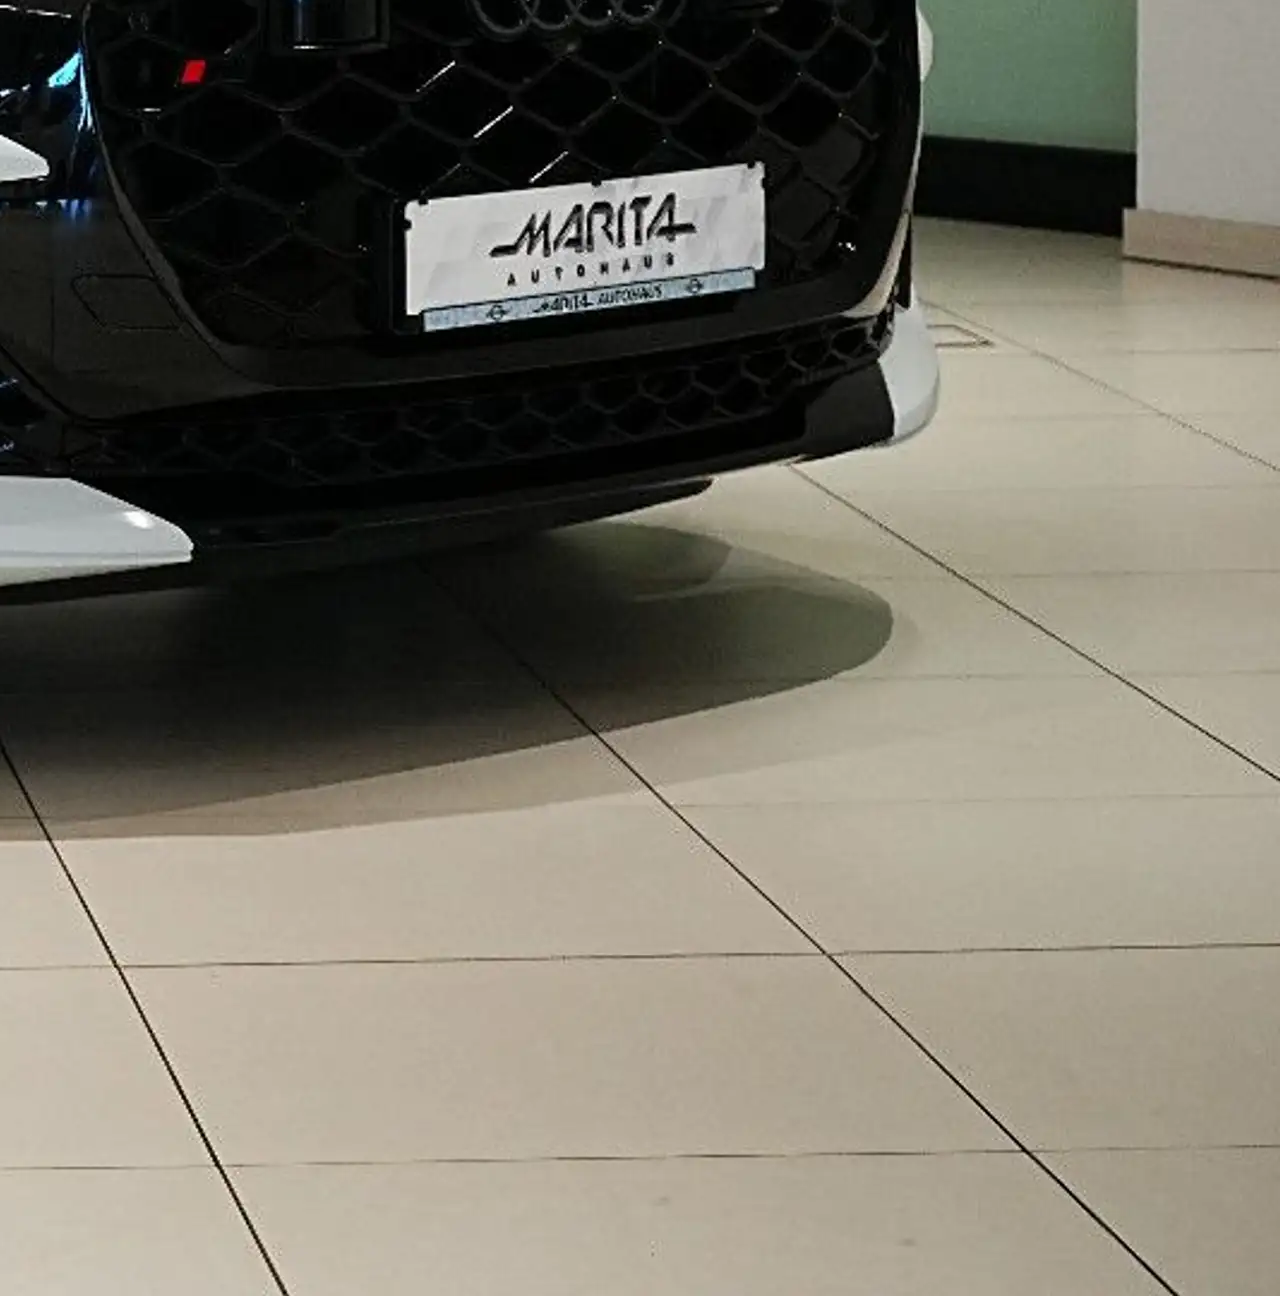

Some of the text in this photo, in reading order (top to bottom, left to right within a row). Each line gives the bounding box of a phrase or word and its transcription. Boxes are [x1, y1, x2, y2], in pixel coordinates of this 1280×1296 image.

[489, 192, 697, 258] MARITA
[506, 252, 675, 286] AUTOHAUS
[597, 283, 663, 306] AUTOHAUS
